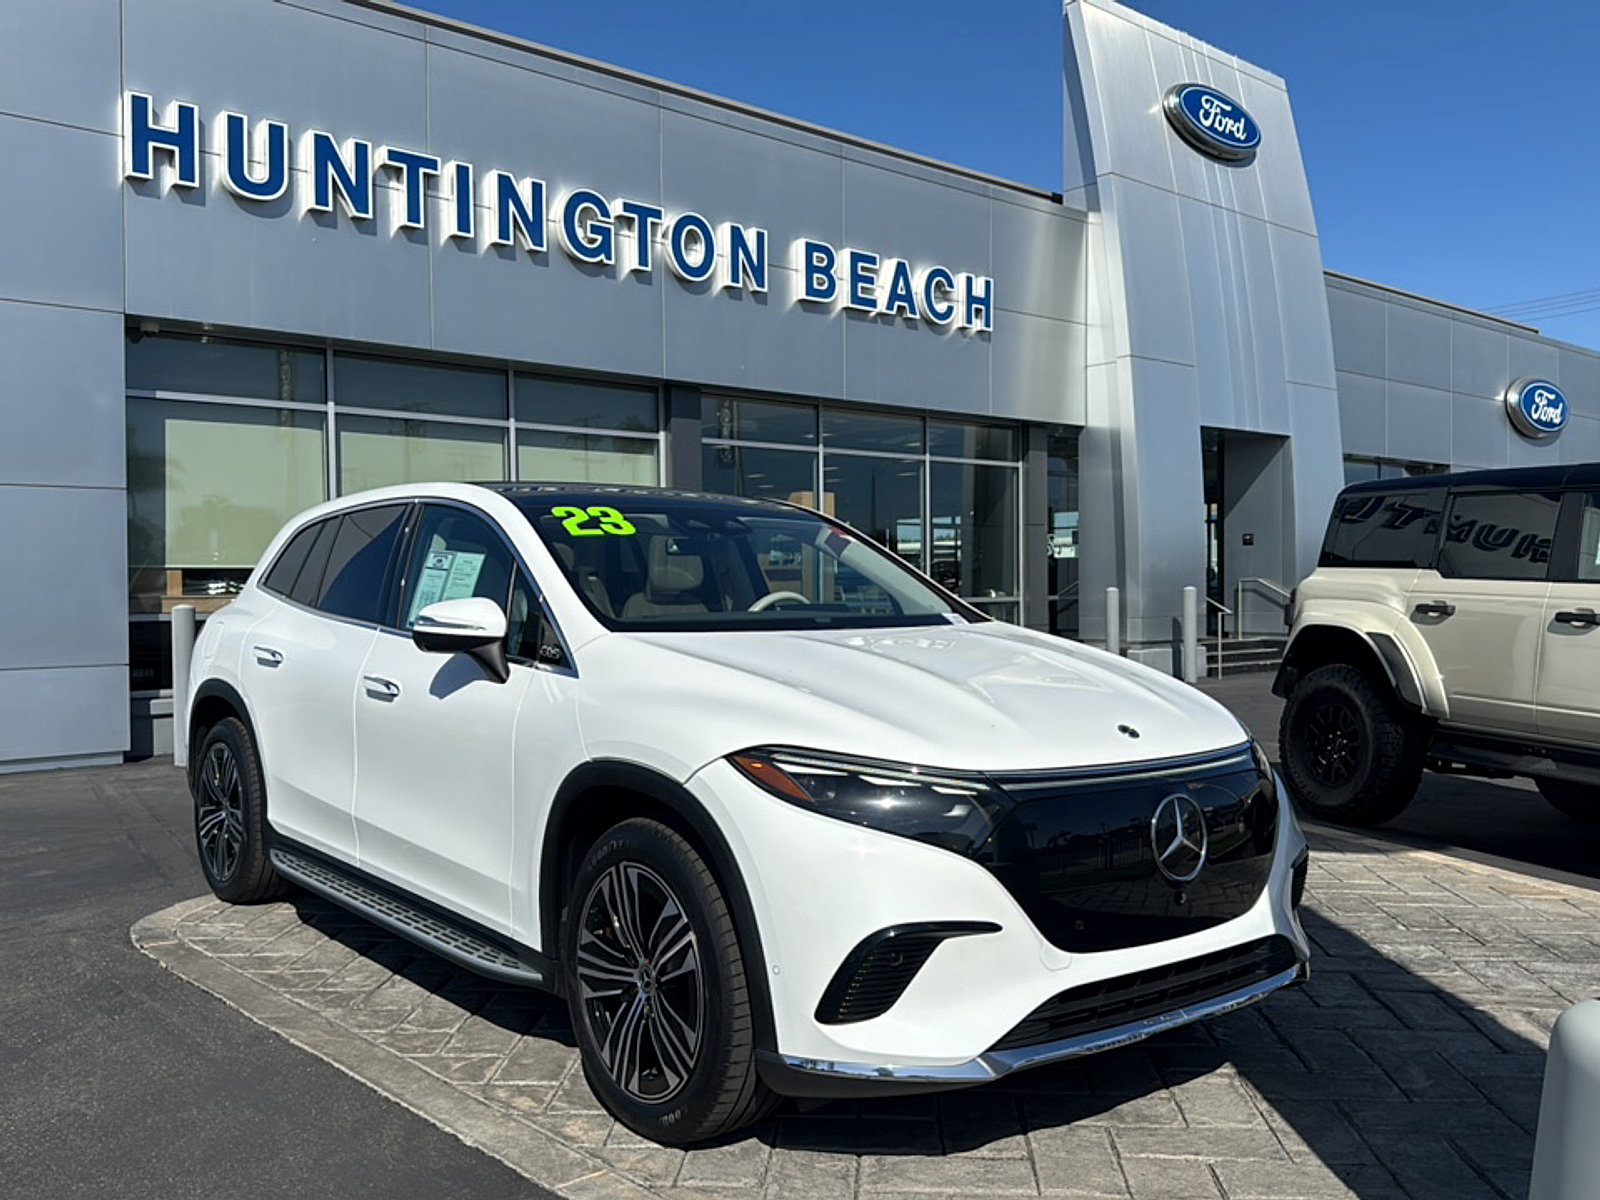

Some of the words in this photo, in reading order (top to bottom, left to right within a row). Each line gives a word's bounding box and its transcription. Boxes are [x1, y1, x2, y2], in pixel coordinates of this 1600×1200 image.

[1199, 95, 1248, 140] Ford
[125, 91, 768, 292] HUNTINGTON
[800, 238, 994, 331] BEACH
[1531, 389, 1563, 425] Ford
[551, 506, 637, 538] 23
